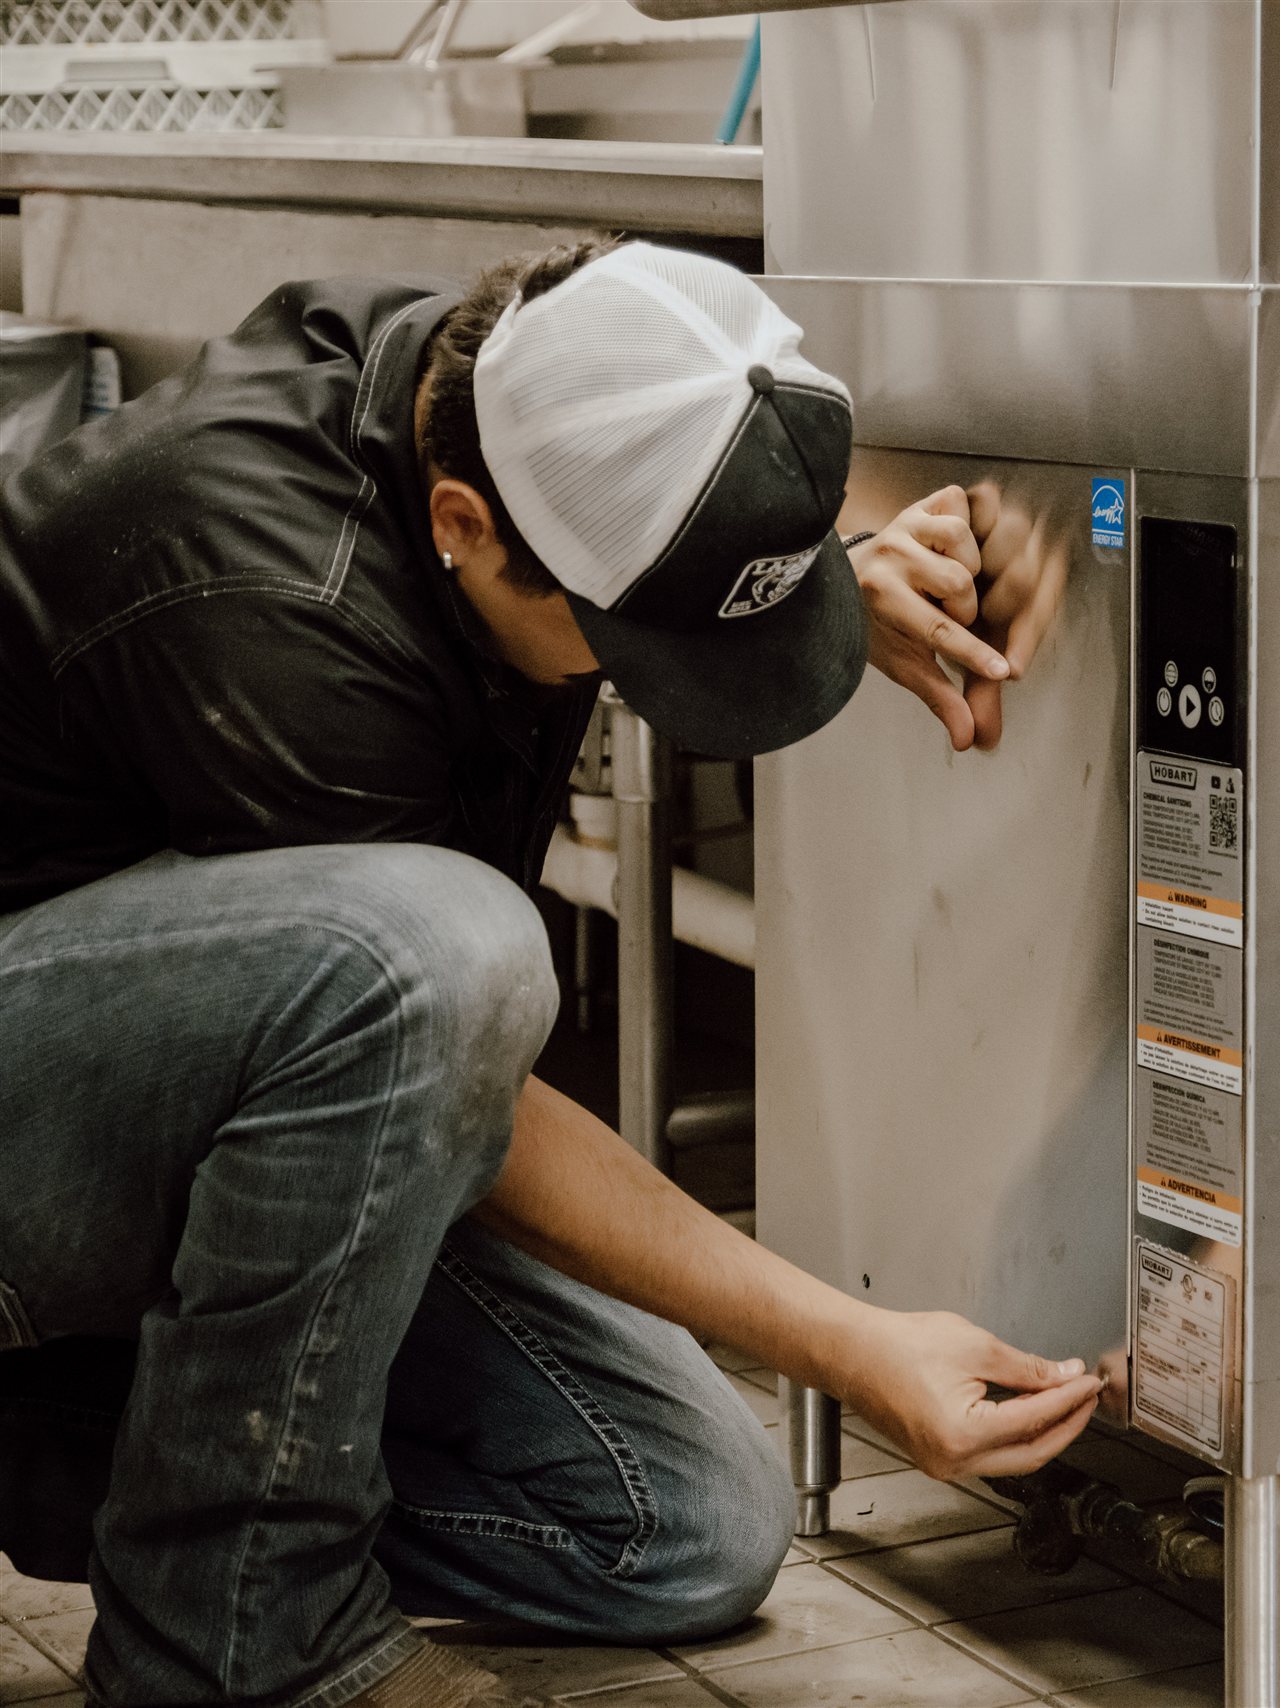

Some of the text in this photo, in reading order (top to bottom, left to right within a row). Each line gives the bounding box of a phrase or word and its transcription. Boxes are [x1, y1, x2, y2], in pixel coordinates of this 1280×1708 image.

[1154, 766, 1193, 782] HOBART
[1175, 893, 1207, 909] WARNING
[1164, 1034, 1221, 1058] AVERTISSEMENT
[1168, 1179, 1216, 1203] ADVERTENCIA
[1144, 1259, 1170, 1276] HOBART
